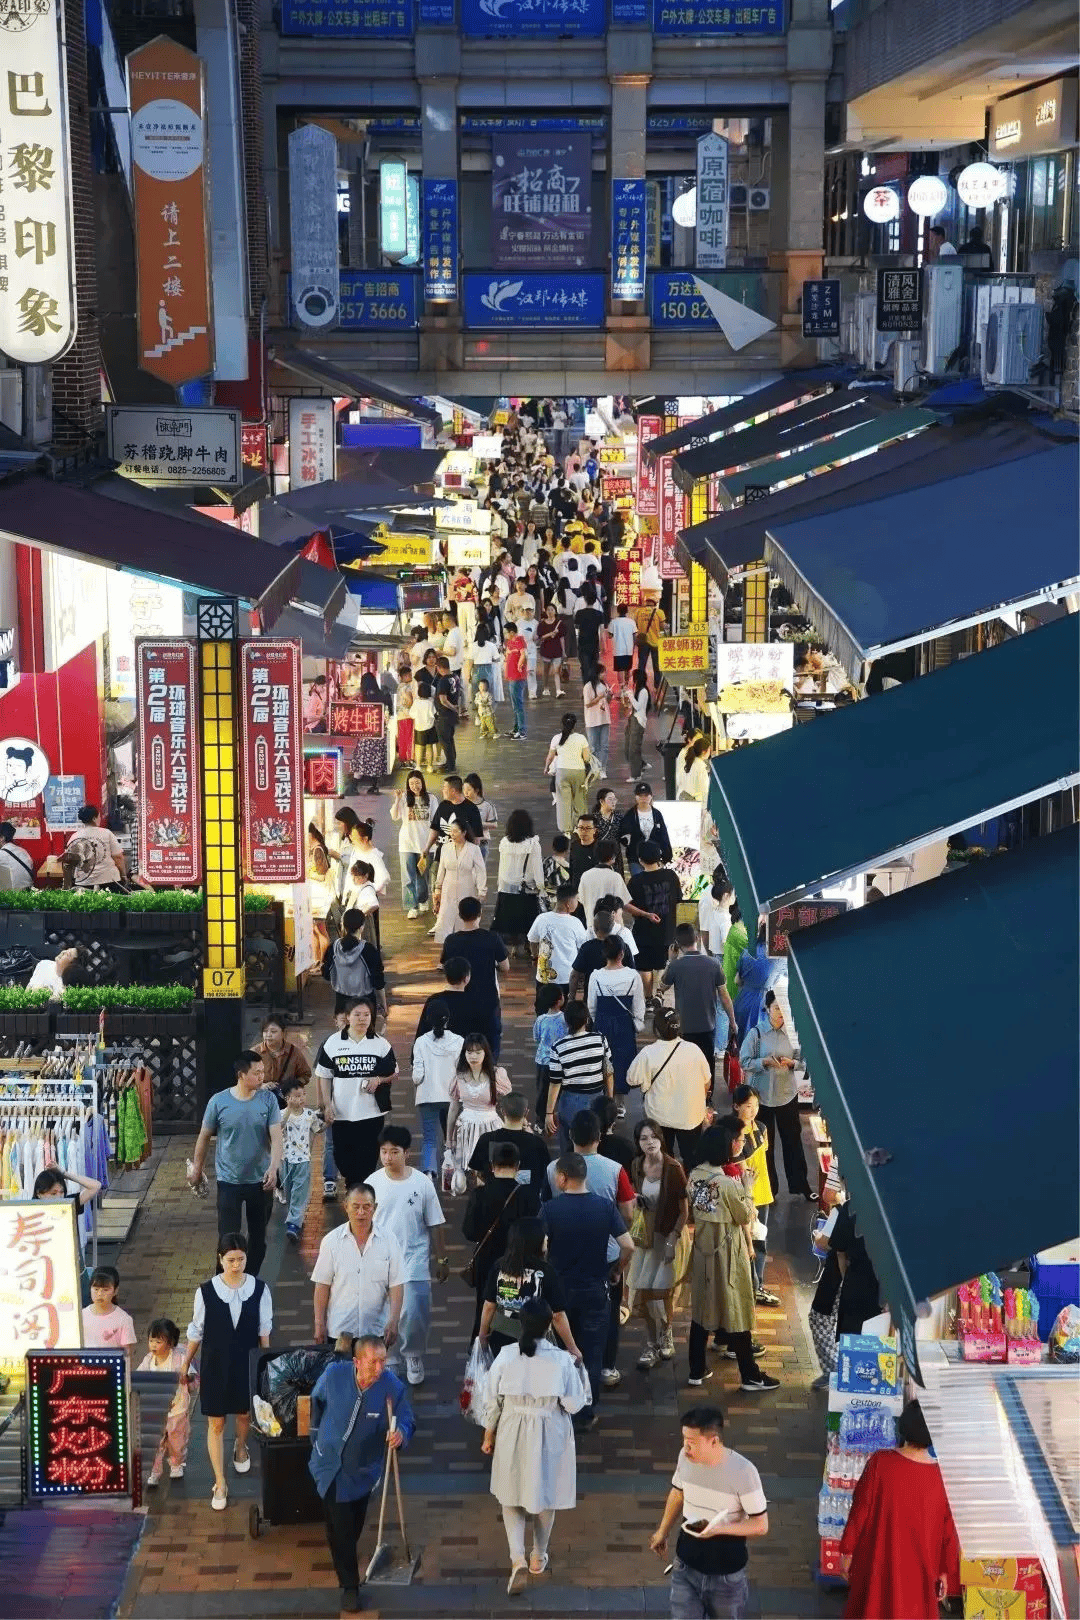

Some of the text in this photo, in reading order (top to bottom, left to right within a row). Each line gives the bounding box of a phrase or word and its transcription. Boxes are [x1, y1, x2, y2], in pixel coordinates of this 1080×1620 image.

[7, 70, 63, 337] 巴黎印象
[701, 156, 724, 249] 原宿咖啡
[873, 190, 890, 206] 茶
[160, 201, 185, 297] 请上二楼
[369, 303, 406, 319] 3666
[517, 289, 588, 308] 汉邦传媒
[661, 302, 686, 319] 150
[124, 443, 228, 463] 苏稽跷脚牛肉
[300, 412, 317, 482] 手工冰粉
[694, 624, 706, 632] 03
[662, 639, 704, 652] 螺蛳粉
[663, 655, 704, 669] 关东煮
[148, 668, 167, 723] 第2届
[251, 668, 270, 723] 第2届
[333, 707, 380, 733] 烤生蚝
[169, 685, 188, 814] 环球音乐大马戏节
[272, 685, 292, 814] 环球音乐大马戏节
[310, 754, 337, 792] 肉
[212, 971, 235, 987] 07
[338, 1064, 375, 1072] MADAME
[7, 1211, 59, 1350] 寿司阁
[47, 1366, 113, 1487] 广东炒粉
